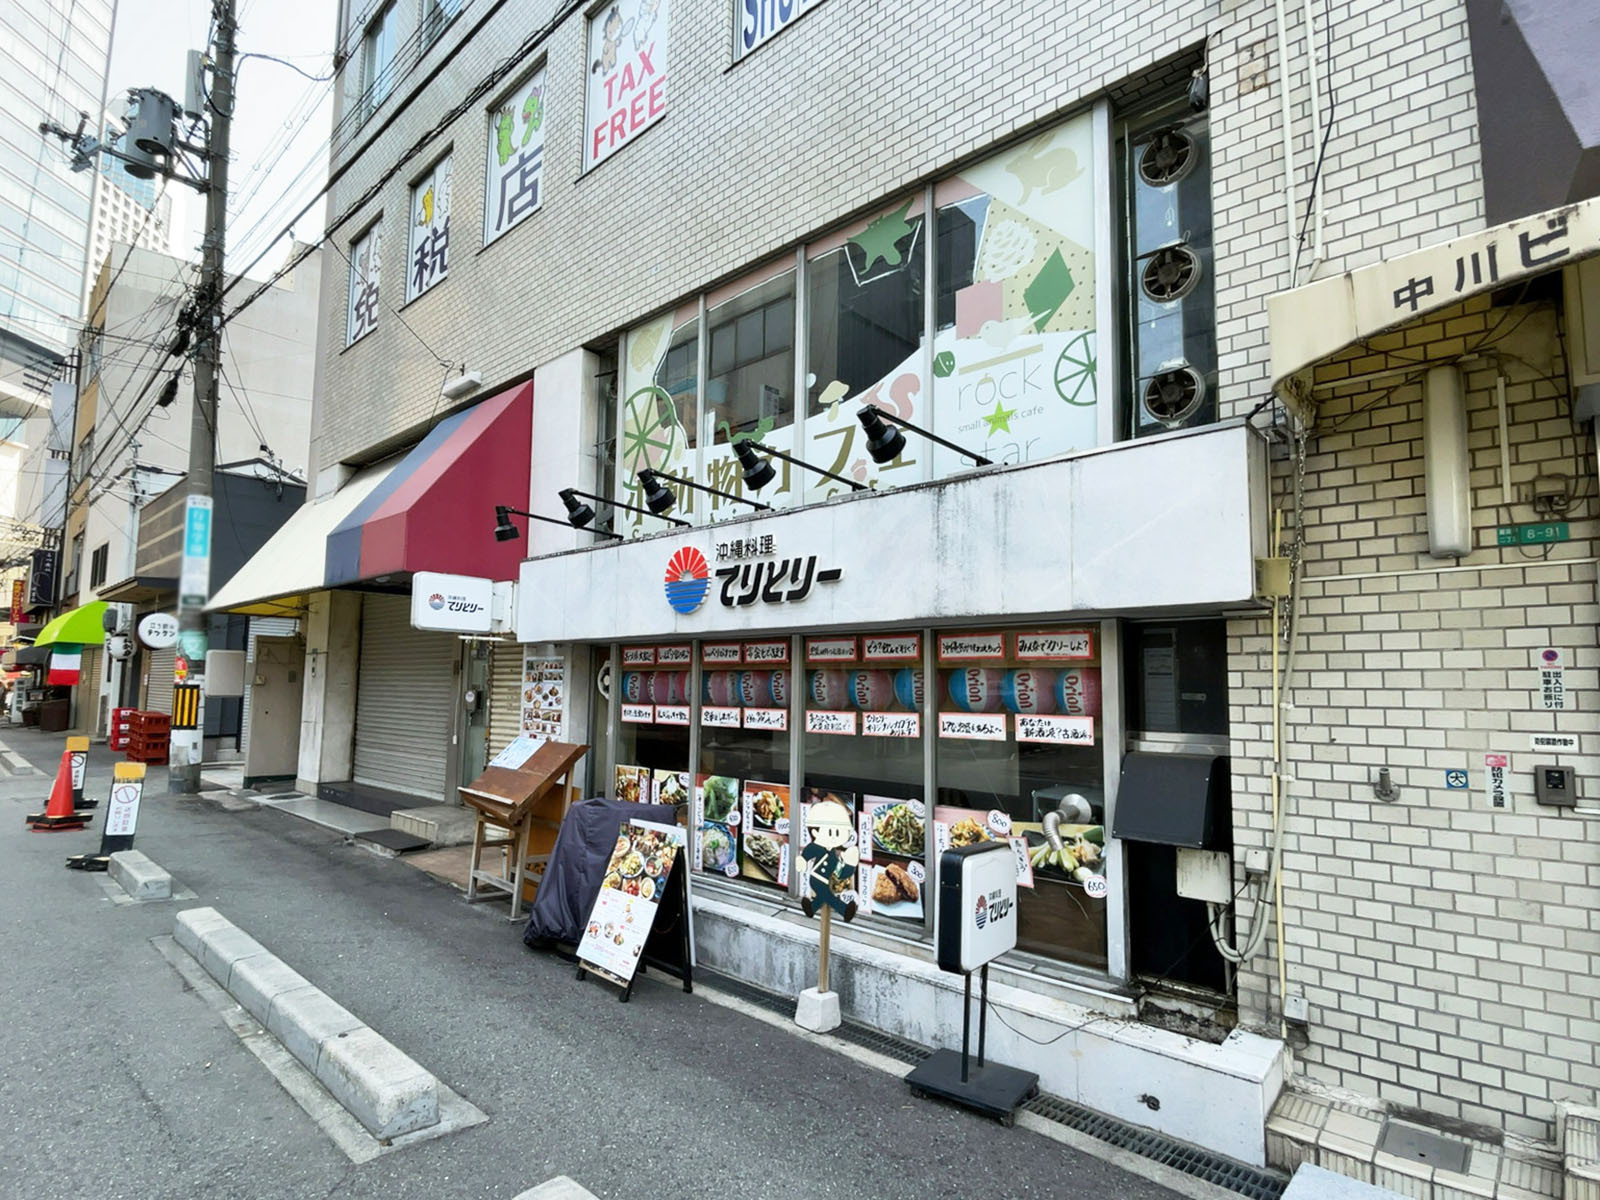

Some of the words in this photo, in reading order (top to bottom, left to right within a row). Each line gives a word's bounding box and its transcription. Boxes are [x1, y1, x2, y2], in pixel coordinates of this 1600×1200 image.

[603, 43, 655, 109] TAX
[593, 75, 667, 160] FREE
[412, 215, 449, 293] 税
[495, 144, 544, 232] 店
[958, 358, 1042, 411] rock
[958, 420, 980, 432] small
[1021, 406, 1044, 418] cafe
[715, 533, 775, 561] 沖縄料理
[772, 672, 784, 701] Orion
[815, 672, 826, 702] Orion
[857, 674, 869, 705] Orion
[967, 669, 984, 703] Orion
[1017, 672, 1034, 709] Orion
[1065, 675, 1082, 714] Orion
[1087, 880, 1106, 893] 650
